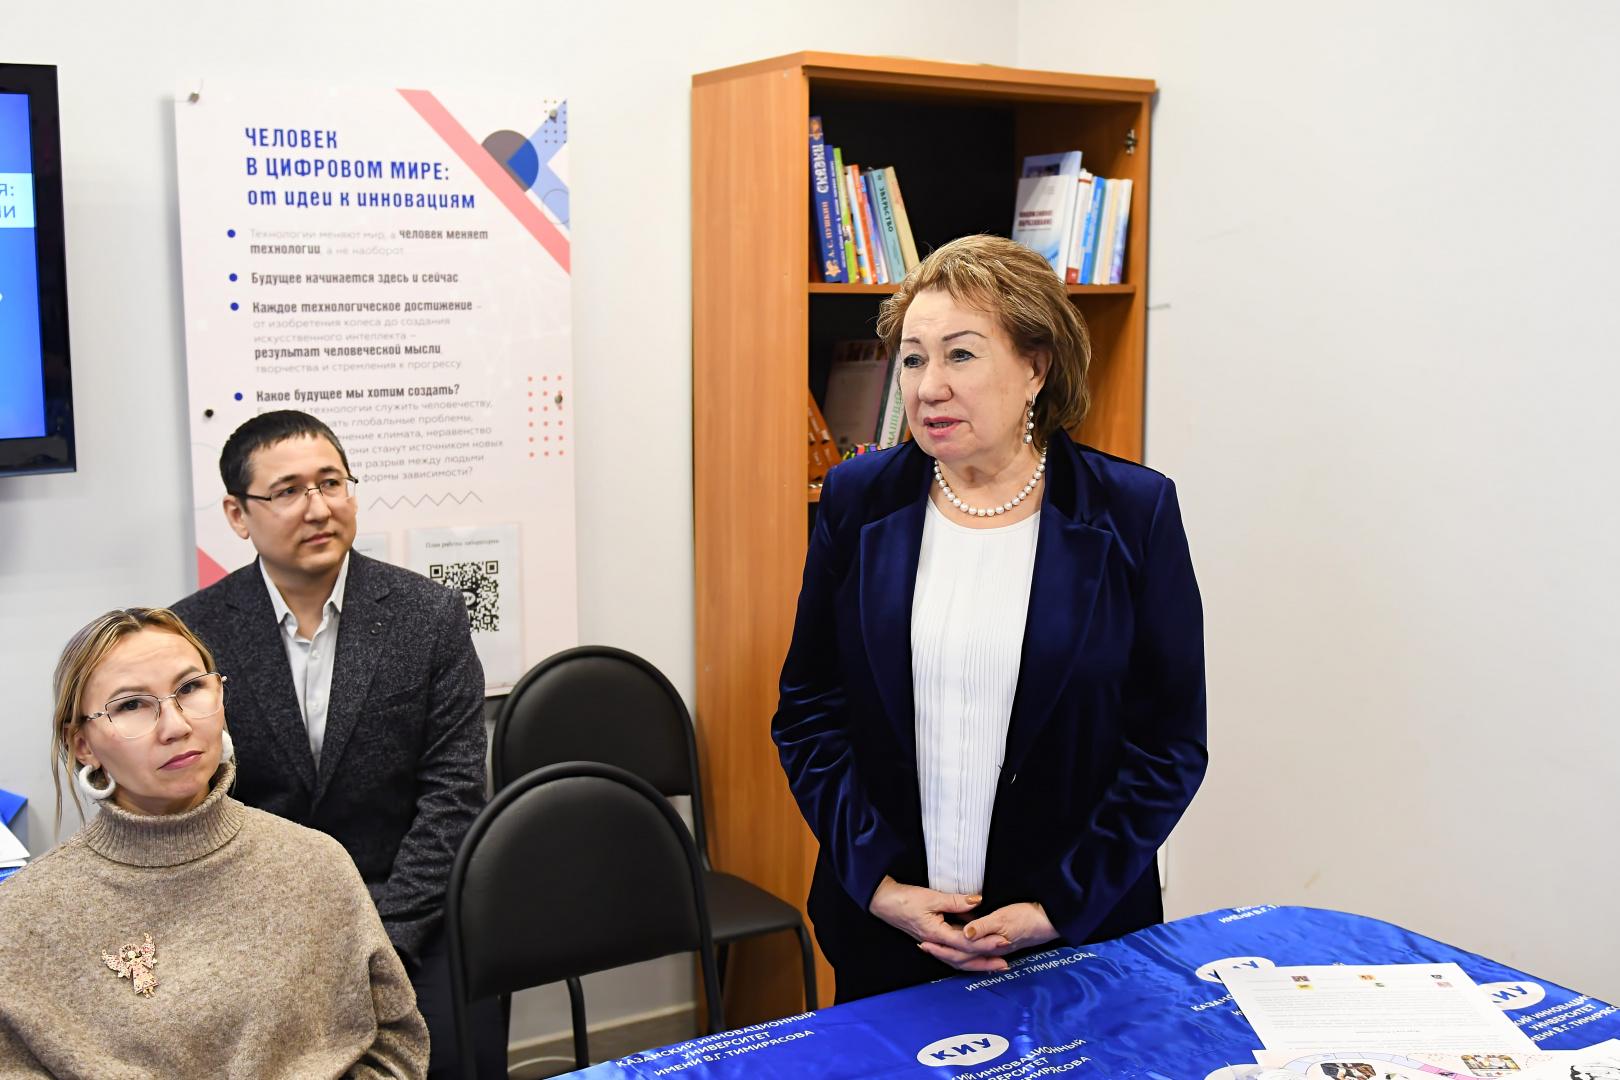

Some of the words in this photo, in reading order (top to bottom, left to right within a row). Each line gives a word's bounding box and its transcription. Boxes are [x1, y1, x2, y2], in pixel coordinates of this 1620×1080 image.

[245, 127, 338, 149] ЧЕЛОВЕК
[246, 157, 258, 176] В
[265, 157, 383, 180] ЦИФРОВОМ
[390, 161, 449, 180] МИРЕ:
[812, 144, 829, 194] СКАЗКИ
[247, 189, 277, 206] от
[284, 190, 332, 209] идеи
[340, 191, 350, 207] к
[357, 191, 475, 211] инновациям
[879, 187, 894, 233] ЗВЕРЬСТВО
[821, 201, 834, 240] ПУШКИН
[250, 228, 317, 240] Технологии
[319, 230, 361, 240] меняют
[390, 232, 397, 240] а
[398, 229, 444, 240] человек
[446, 230, 489, 240] меняет
[326, 247, 333, 256] а
[336, 246, 350, 256] не
[251, 272, 302, 286] Будущее
[305, 273, 375, 284] начинается
[377, 273, 410, 285] здесь
[412, 273, 419, 284] и
[252, 301, 298, 315] Каждое
[301, 302, 402, 313] технологическое
[404, 300, 474, 313] достижение
[253, 320, 266, 330] от
[268, 317, 342, 330] изобретения
[344, 318, 382, 328] колеса
[384, 318, 399, 328] до
[400, 316, 451, 327] создания
[253, 332, 343, 345] искусственного
[345, 330, 408, 342] интеллекта
[254, 346, 321, 361] результат
[323, 343, 402, 357] человеческой
[255, 363, 320, 375] творчества
[322, 363, 330, 372] и
[331, 361, 397, 373] стремления
[399, 361, 405, 370] к
[256, 389, 291, 402] Какое
[294, 387, 343, 403] будущее
[345, 387, 364, 399] мы
[366, 386, 405, 399] хотим
[407, 382, 461, 398] создать?
[309, 404, 373, 415] технологии
[374, 402, 419, 413] служить
[421, 400, 493, 410] человечеству,
[351, 414, 416, 426] глобальные
[418, 412, 474, 425] проблемы,
[377, 429, 424, 440] климата,
[426, 427, 492, 439] неравенство
[348, 446, 370, 456] они
[371, 444, 407, 455] станут
[408, 441, 470, 452] источником
[472, 439, 504, 449] новых
[365, 459, 405, 470] разрыв
[407, 456, 442, 468] между
[444, 453, 485, 464] людьми
[361, 472, 400, 484] формы
[401, 466, 474, 481] зависимости?
[965, 974, 1005, 992] ИМЕНИ
[1023, 951, 1098, 974] ТИМИРЯСОВА
[1190, 993, 1235, 1011] КАЗАНС
[1491, 985, 1528, 1004] ИУ
[1528, 1003, 1597, 1031] УНИВЕРСИТЕТ
[1530, 994, 1591, 1020] ИННОВАЦИ
[615, 1042, 697, 1068] КАЗАНСКИЙ
[696, 1011, 817, 1045] ИННОВАЦИОННЫЙ
[680, 1031, 772, 1060] УНИВЕРСИТЕТ
[930, 1037, 992, 1061] КИУ
[653, 1058, 702, 1077] ИМЕНИ
[727, 1029, 816, 1058] ТИМИРЯСОВА
[975, 1038, 1087, 1079] ИННОВАЦИОННЫЙ
[1021, 1056, 1092, 1080] МИРЯСОВА
